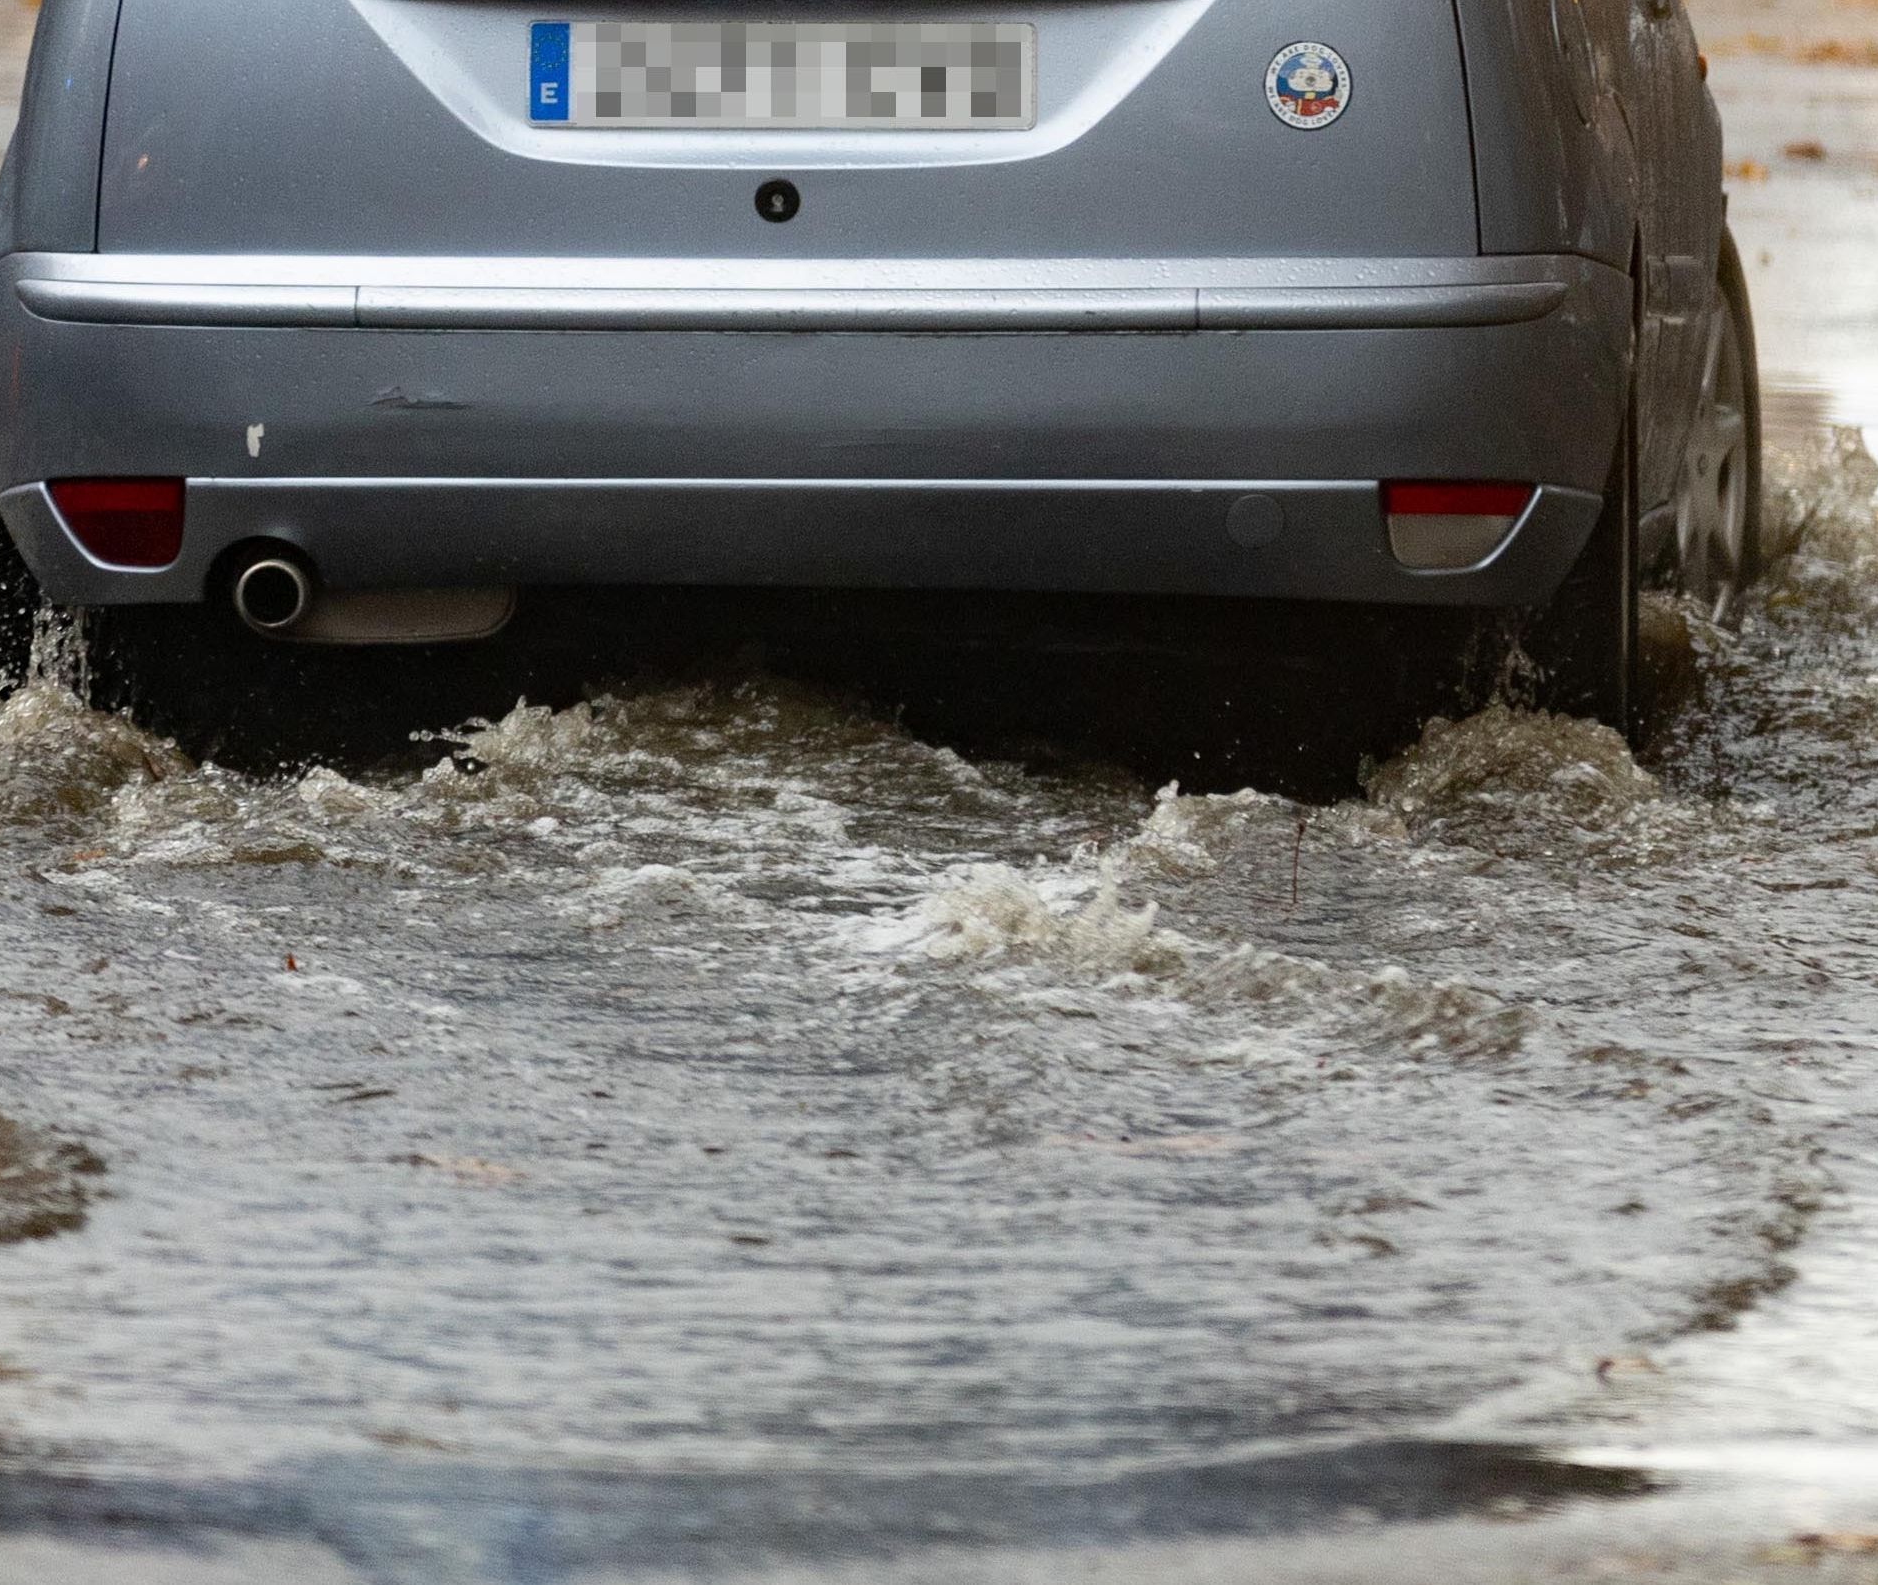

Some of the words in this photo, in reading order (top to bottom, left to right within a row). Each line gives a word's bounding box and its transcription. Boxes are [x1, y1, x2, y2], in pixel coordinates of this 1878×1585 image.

[1282, 46, 1299, 58] ARE
[1303, 45, 1326, 54] DOG
[1328, 51, 1347, 88] LOVERS
[540, 82, 559, 105] E
